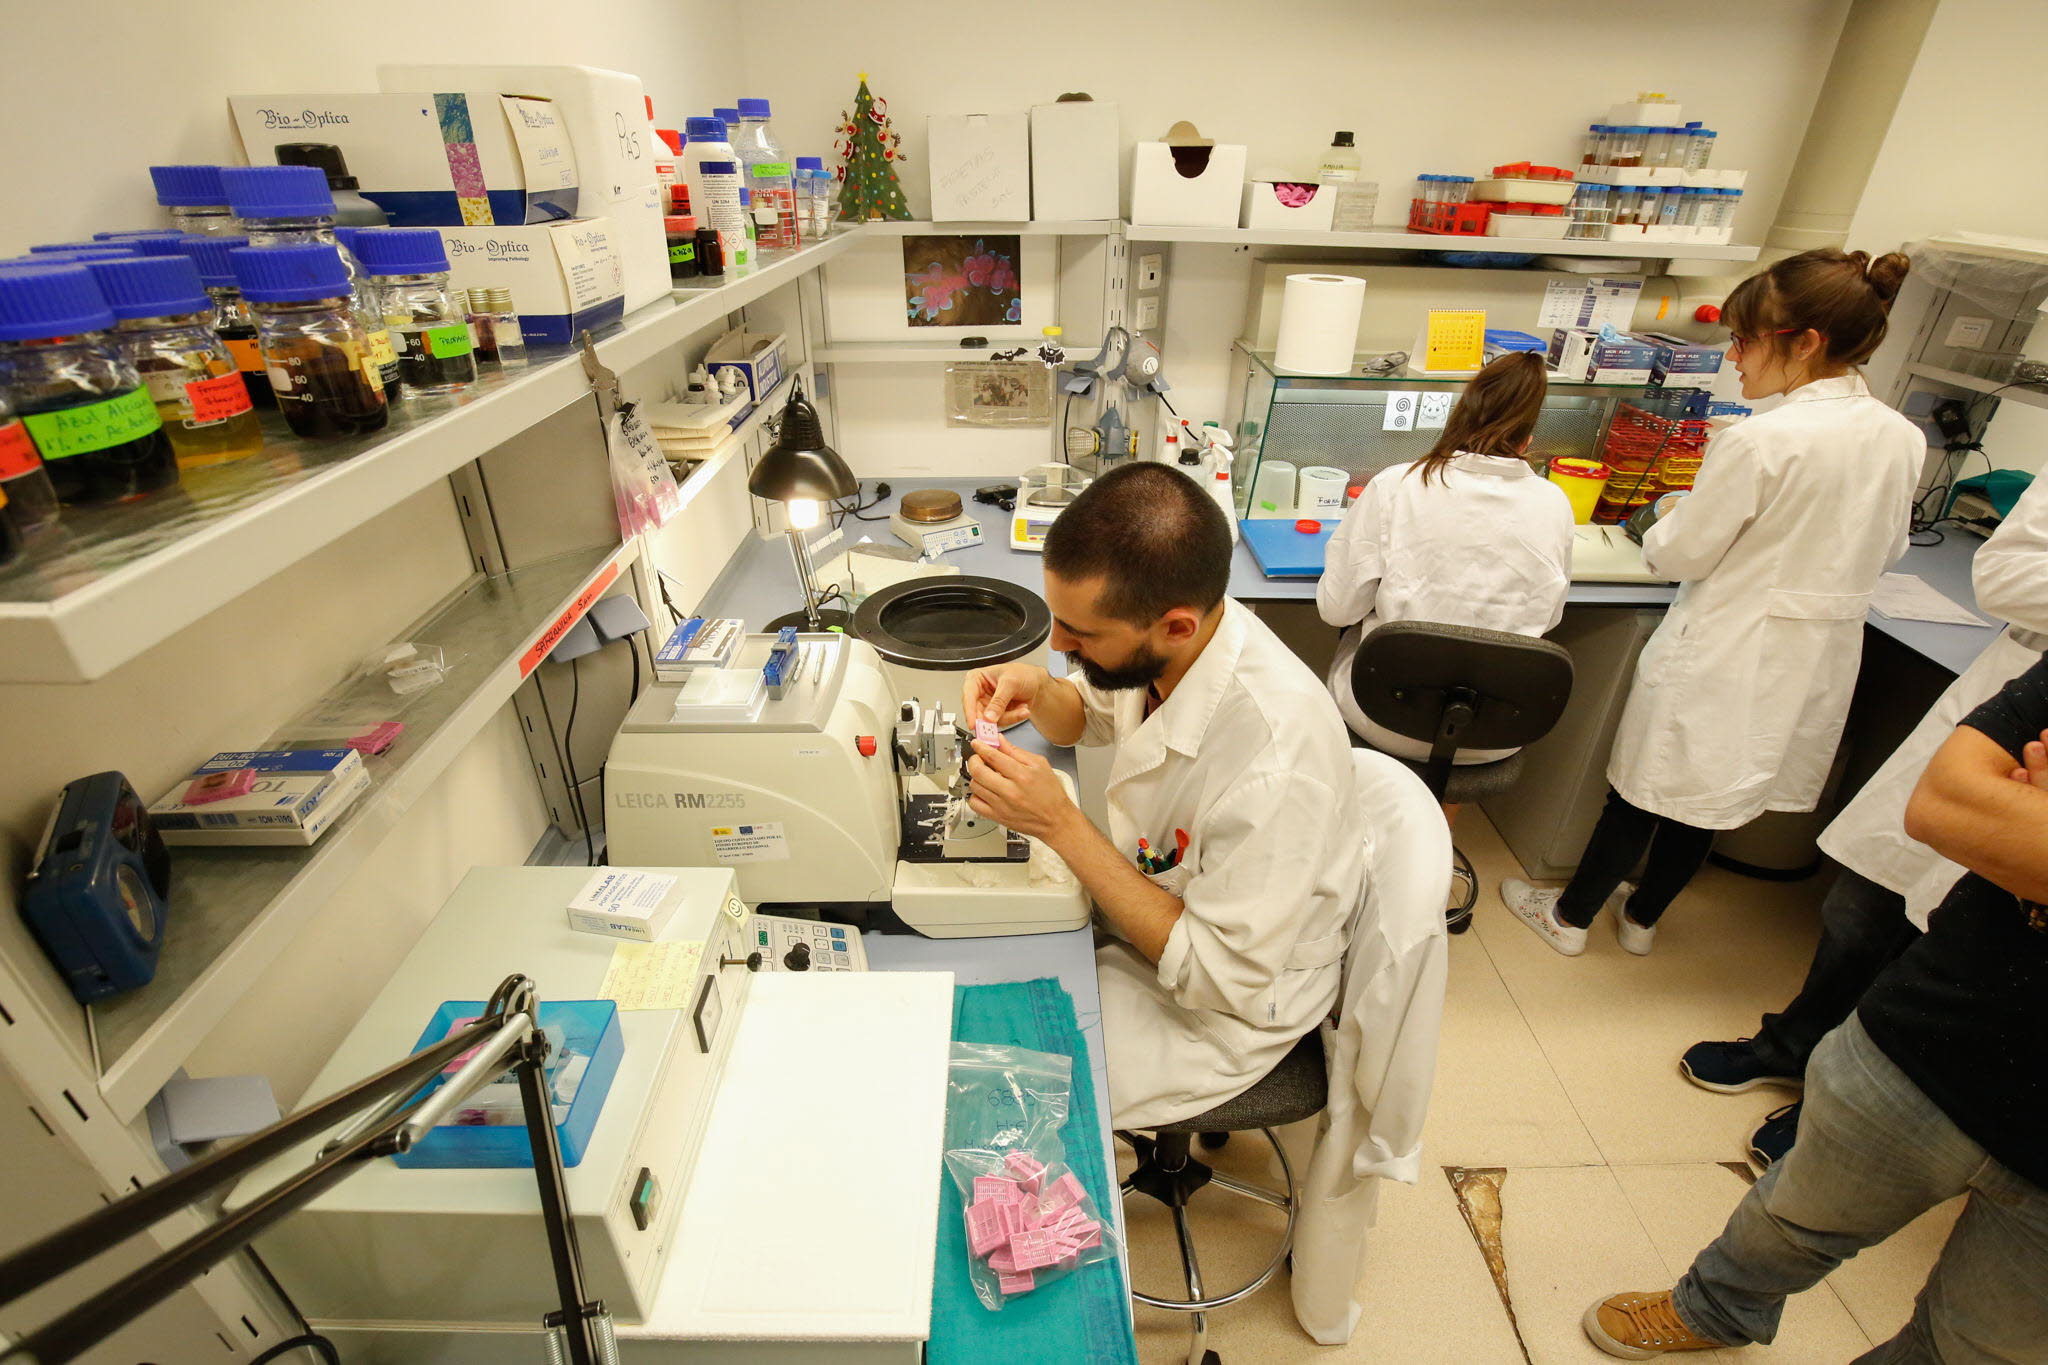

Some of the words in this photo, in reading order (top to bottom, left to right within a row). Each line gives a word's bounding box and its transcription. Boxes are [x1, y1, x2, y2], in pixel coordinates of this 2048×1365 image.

[615, 112, 641, 160] PAS
[410, 338, 421, 346] 60
[288, 356, 301, 366] 80
[414, 354, 425, 362] 40
[294, 375, 308, 385] 60
[301, 393, 314, 403] 40
[614, 793, 669, 808] LEICA
[674, 793, 746, 808] RM2255
[607, 903, 620, 913] 50
